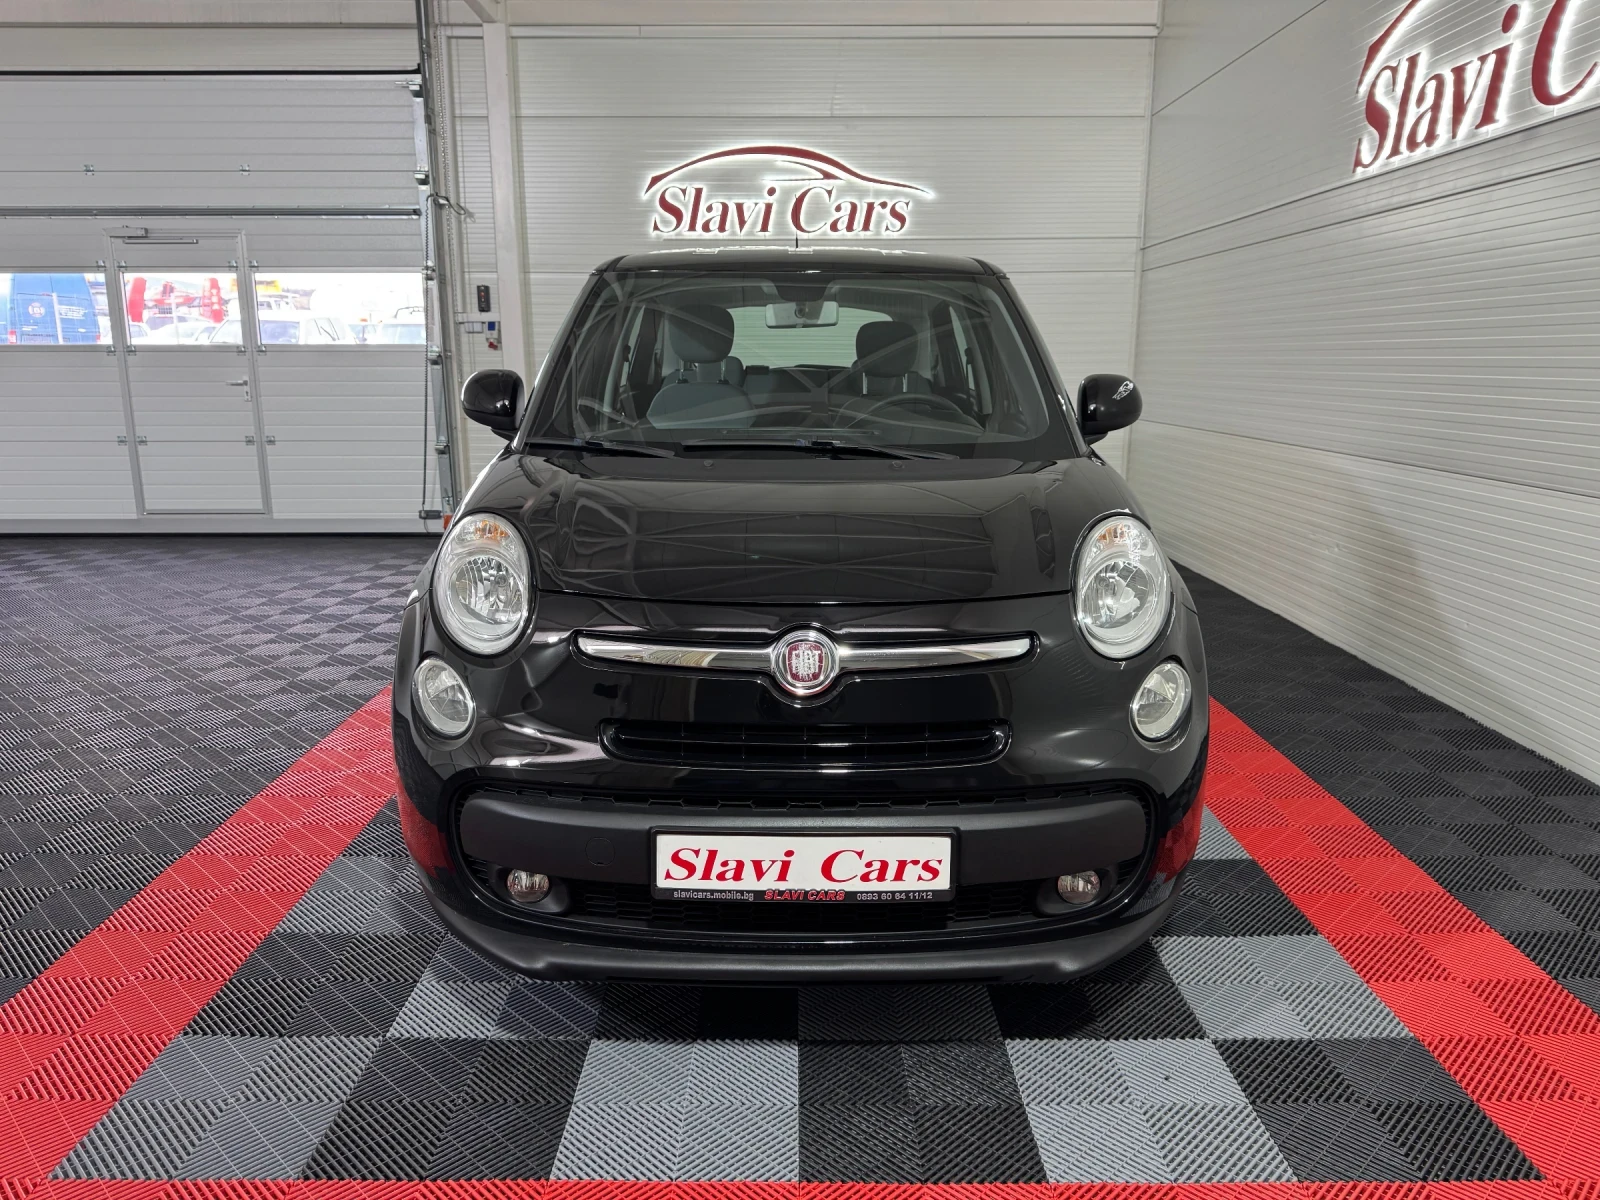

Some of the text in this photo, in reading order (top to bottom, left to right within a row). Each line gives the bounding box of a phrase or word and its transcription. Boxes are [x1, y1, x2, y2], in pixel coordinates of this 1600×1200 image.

[1352, 3, 1519, 174] Slavi
[652, 186, 911, 234] Slavi Cars
[664, 847, 943, 883] Slavi Cars
[673, 889, 754, 902] slavicars.mobile.bg
[764, 889, 846, 901] SLAVI CARS
[908, 891, 933, 900] 11/12
